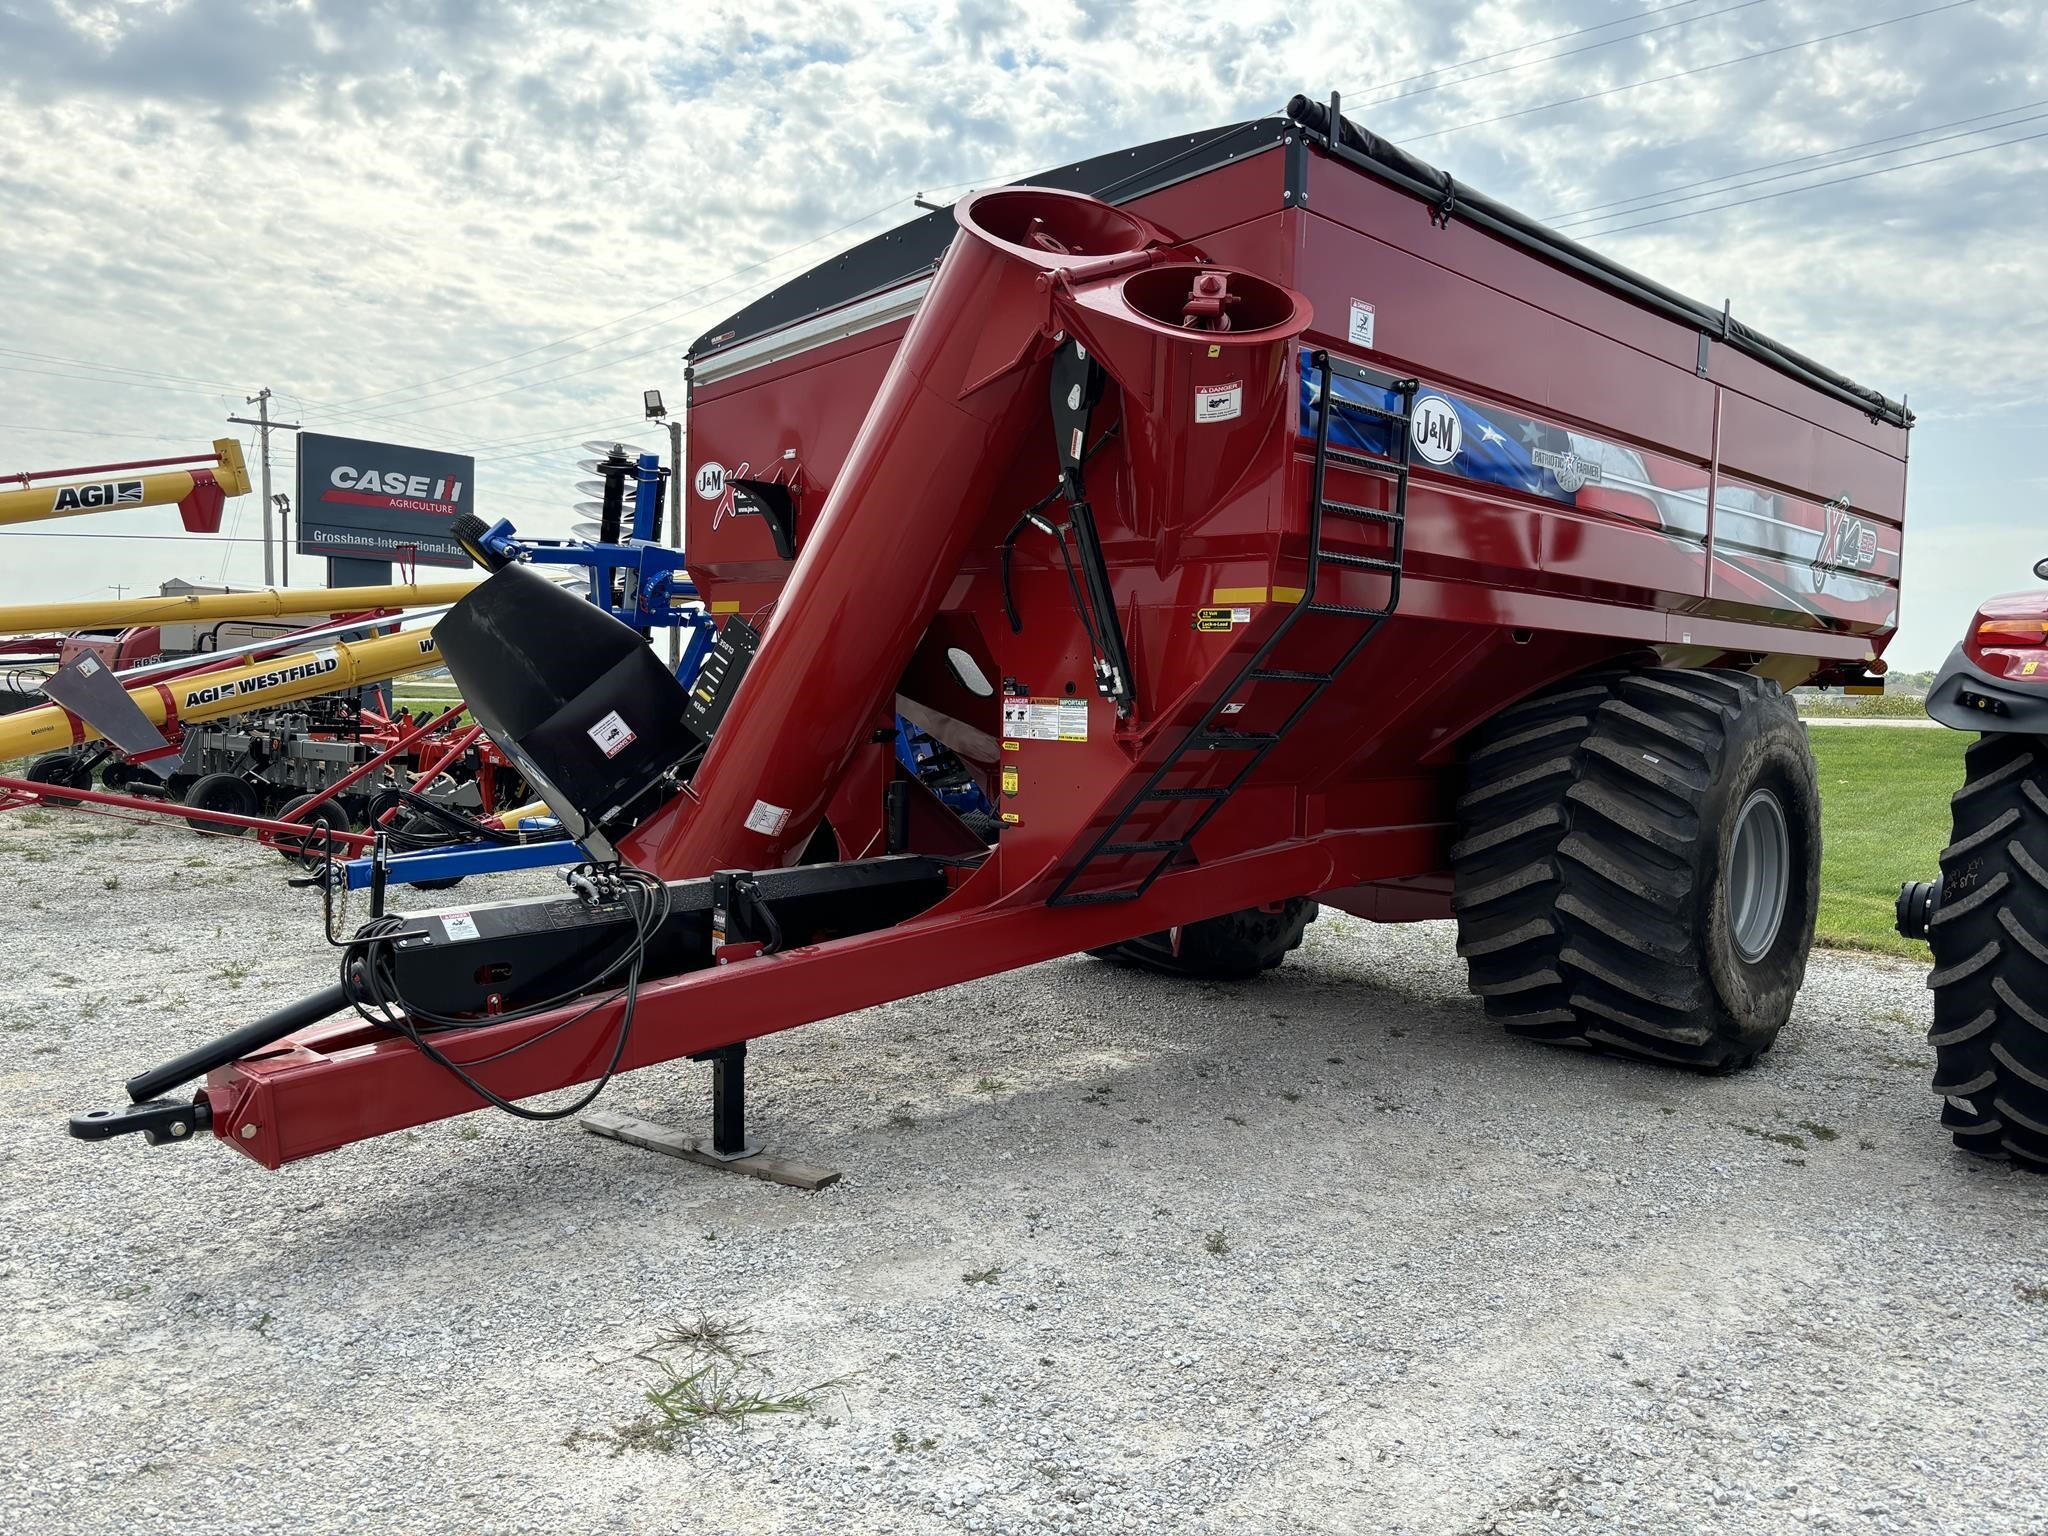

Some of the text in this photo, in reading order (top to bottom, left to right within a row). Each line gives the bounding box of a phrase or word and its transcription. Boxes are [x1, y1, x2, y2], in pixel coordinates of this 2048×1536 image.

[1208, 383, 1238, 393] DANGER
[1416, 409, 1456, 452] J&M
[1534, 451, 1599, 478] PATRIOTIC FARMER
[330, 466, 431, 498] CASE
[698, 470, 722, 492] J&M
[54, 483, 115, 511] AGI
[389, 499, 453, 514] AGRICULTURE
[313, 530, 375, 546] Grosshans
[719, 639, 735, 655] CLOSE
[186, 658, 338, 708] AGI WESTFIELD
[693, 700, 706, 714] OPEN
